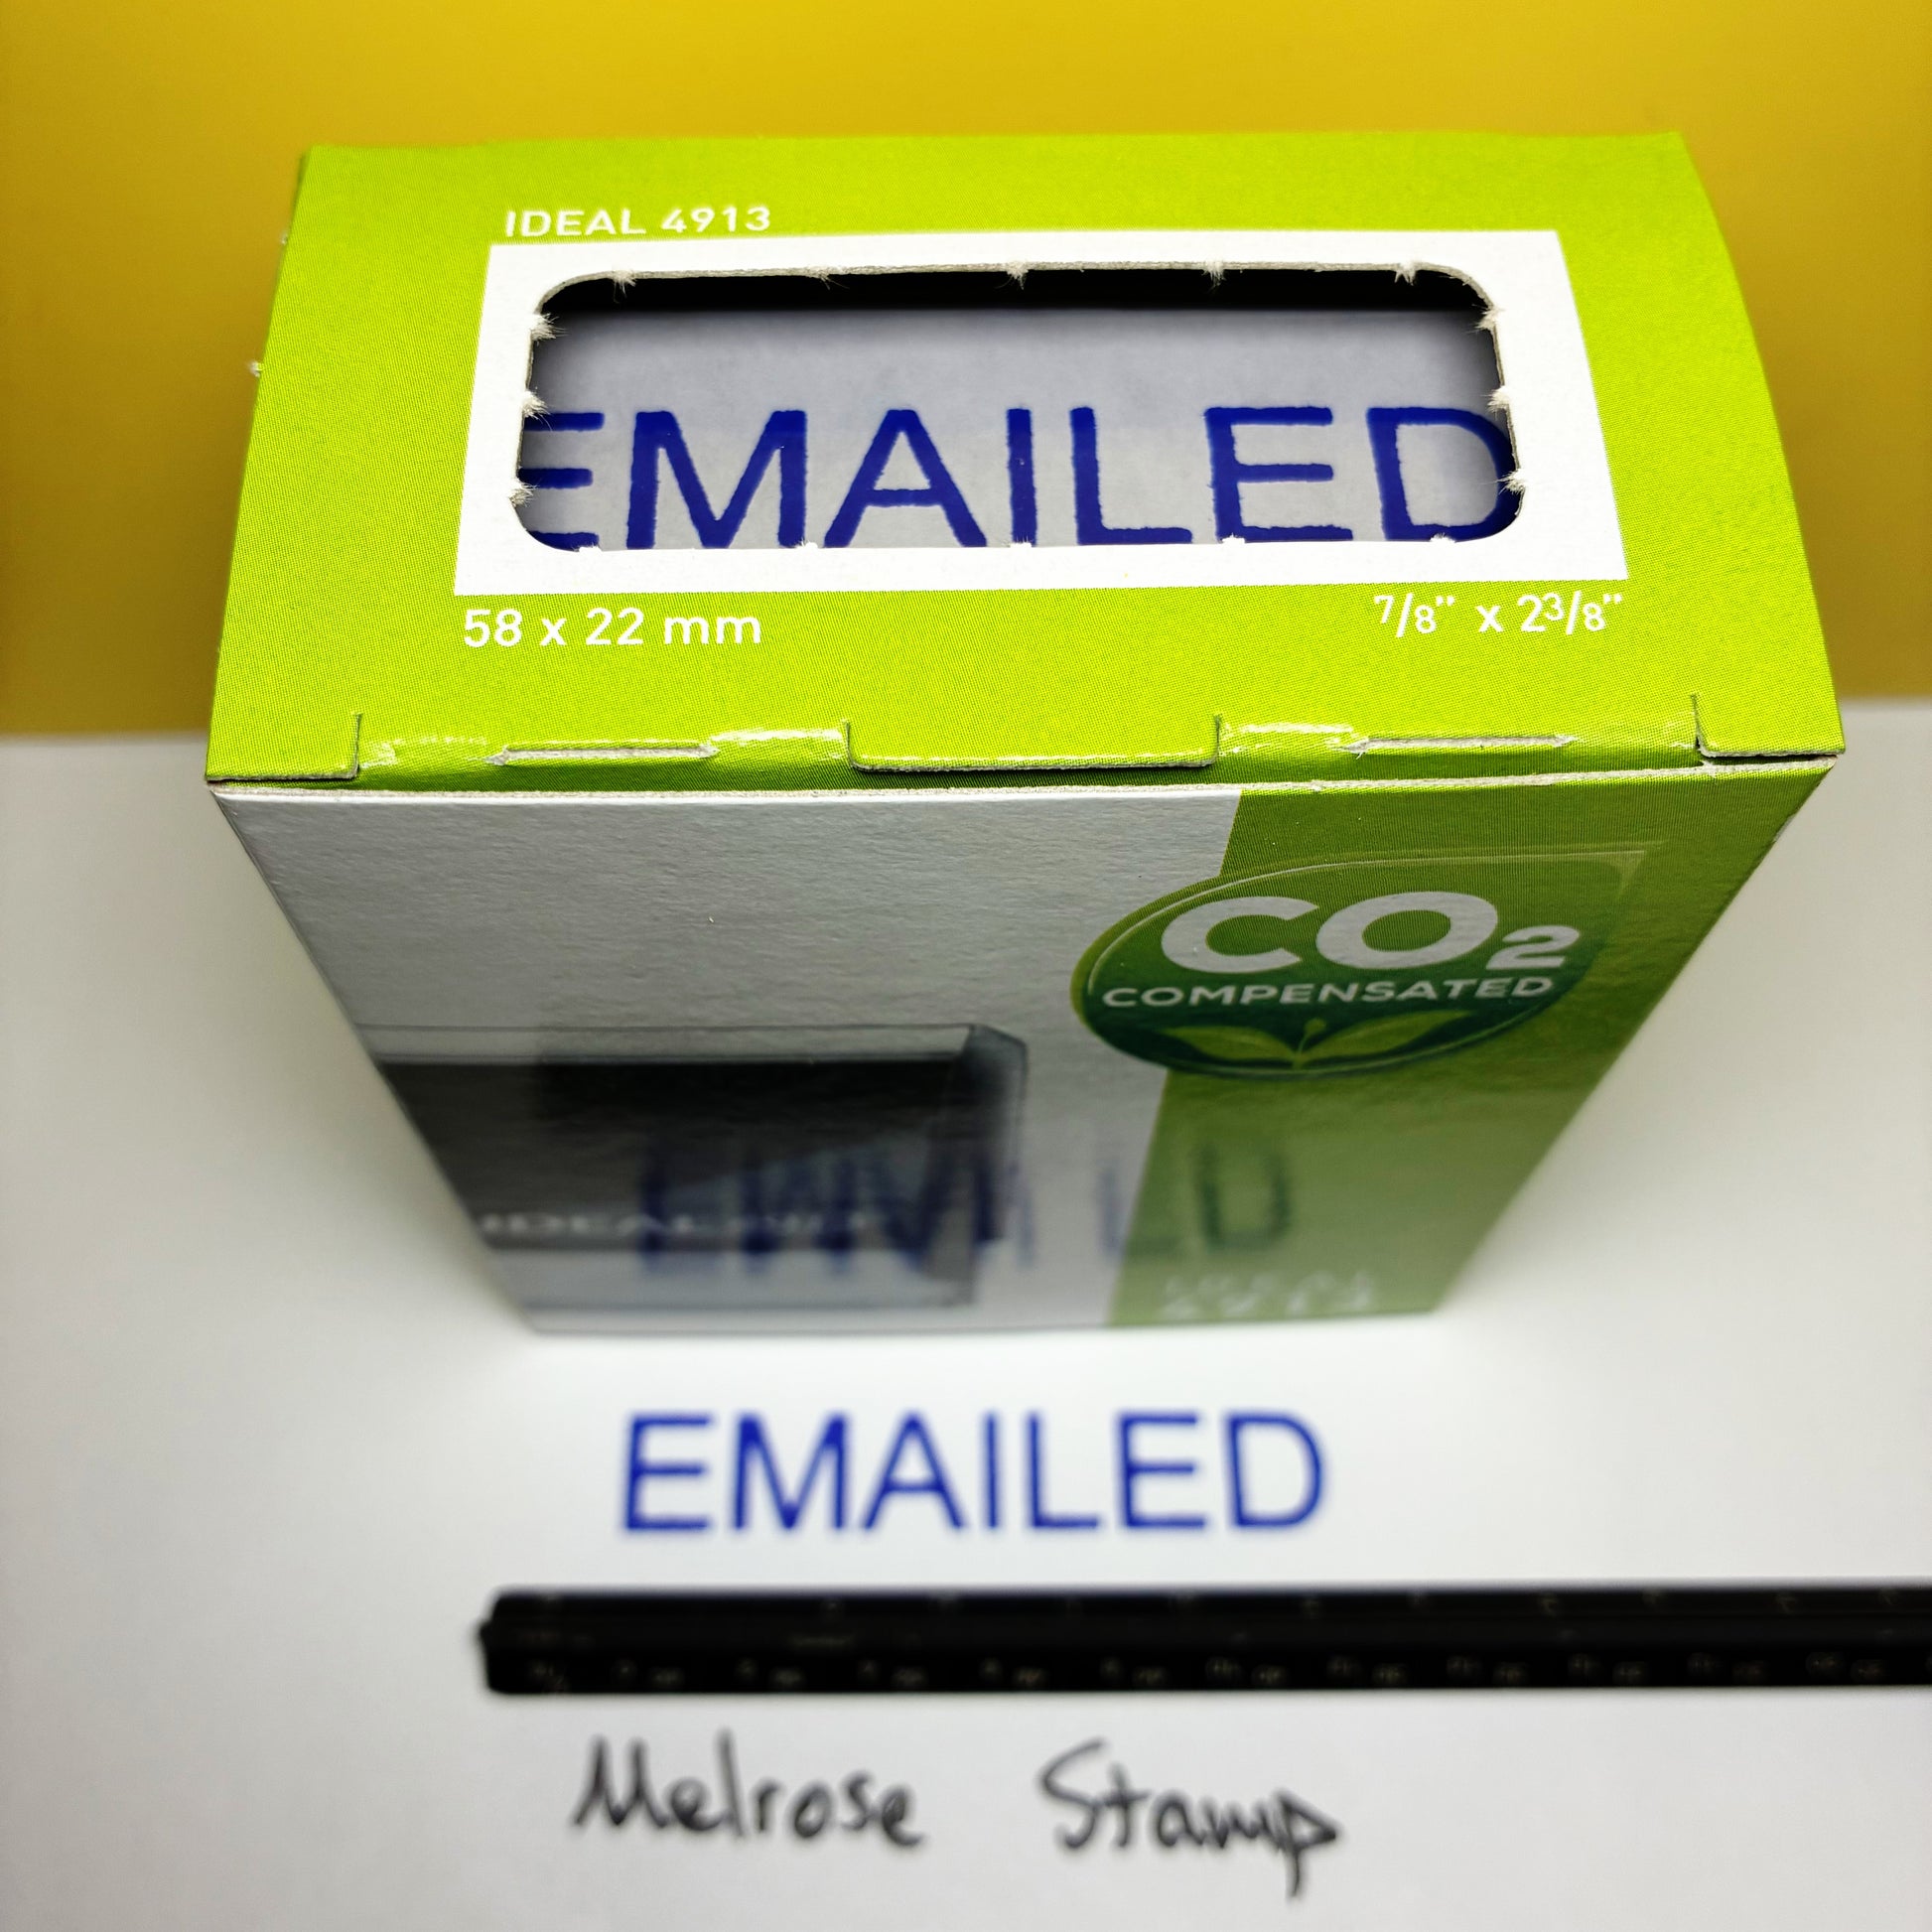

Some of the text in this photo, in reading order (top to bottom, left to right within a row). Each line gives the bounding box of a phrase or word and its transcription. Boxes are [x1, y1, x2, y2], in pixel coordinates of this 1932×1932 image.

[504, 206, 770, 237] IDEAL 4913
[464, 608, 761, 647] 58 x 22 mm
[1475, 605, 1504, 632] x
[1101, 976, 1556, 1008] COMPENSATED
[622, 1411, 1327, 1534] EMAILED
[573, 1727, 1343, 1898] Melrose Stamp
